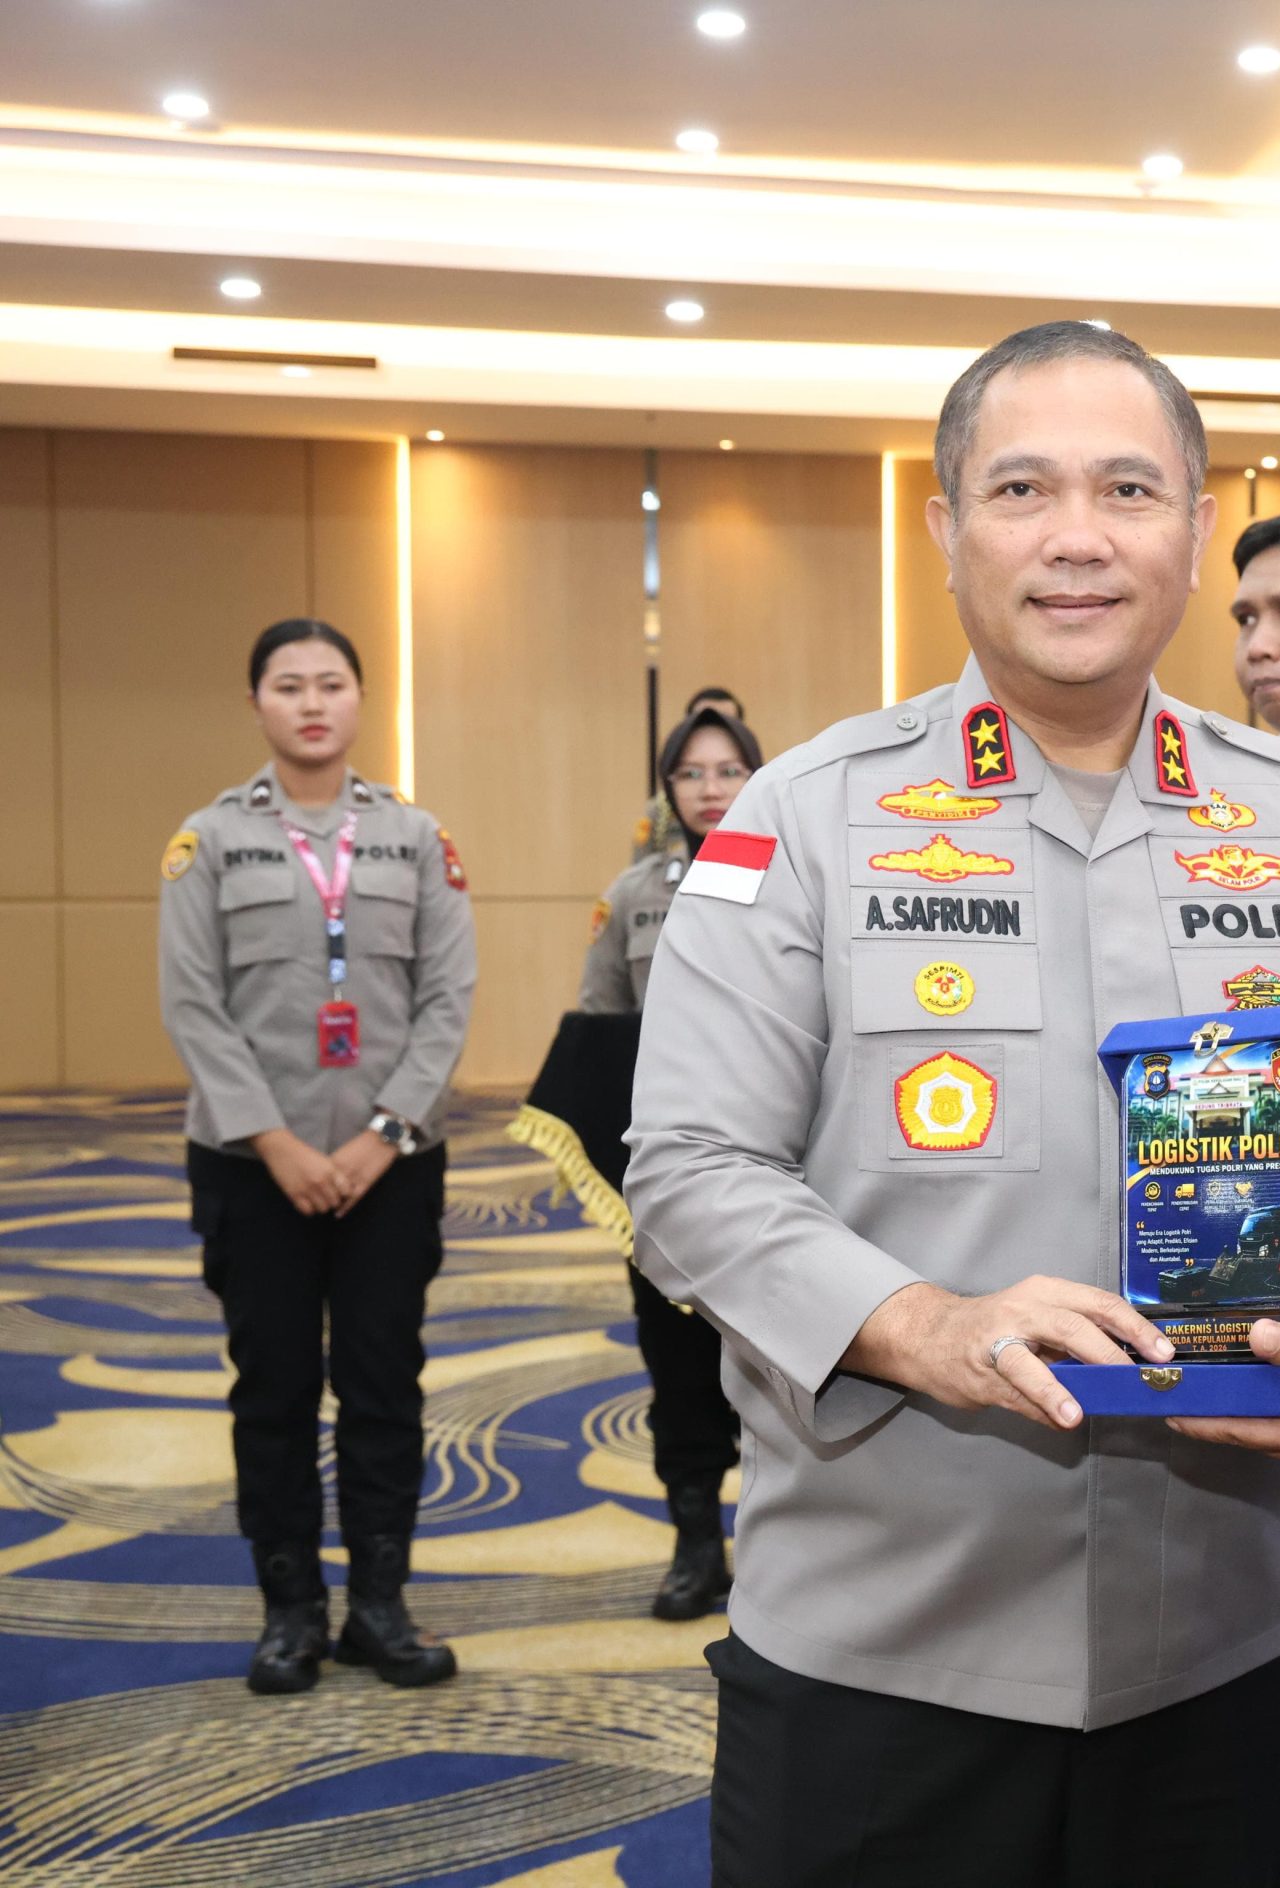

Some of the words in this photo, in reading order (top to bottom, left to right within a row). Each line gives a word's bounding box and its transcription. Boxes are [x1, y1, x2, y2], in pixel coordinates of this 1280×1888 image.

[866, 895, 1021, 937] A.SAFRUDIN
[1138, 1135, 1233, 1166] LOGISTIK
[1150, 1166, 1195, 1176] MENDUKUNG
[1197, 1165, 1220, 1174] TUGAS
[1222, 1164, 1243, 1172] POLRI
[1245, 1163, 1264, 1171] YANG
[1164, 1229, 1180, 1237] Logistik
[1165, 1323, 1212, 1335] RAKERNIS
[1214, 1322, 1254, 1334] LOGISTI
[1192, 1334, 1236, 1344] KEPULAUAN
[1238, 1334, 1250, 1342] RIA
[1209, 1344, 1228, 1352] 2026
